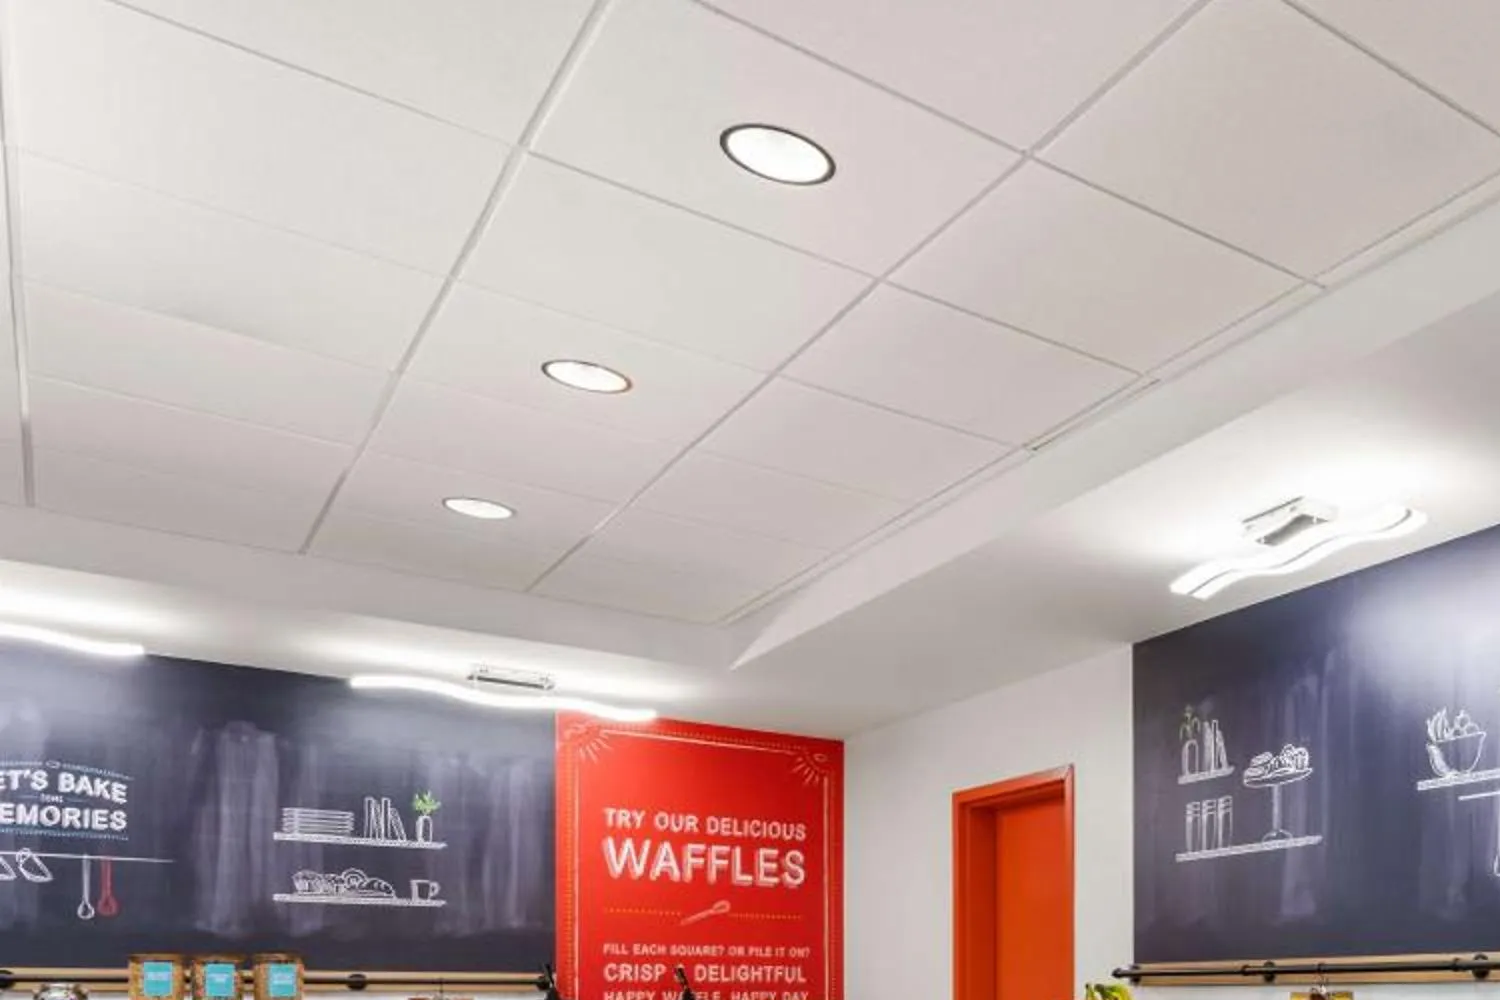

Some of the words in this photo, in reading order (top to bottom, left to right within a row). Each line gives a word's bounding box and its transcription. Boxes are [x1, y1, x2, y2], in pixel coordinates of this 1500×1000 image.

[58, 771, 128, 804] BAKE
[604, 807, 645, 829] TRY
[654, 811, 698, 833] OUR
[706, 815, 807, 841] DELICIOUS
[603, 836, 806, 888] WAFFLES
[603, 943, 628, 956] FILL
[633, 943, 667, 957] EACH
[669, 945, 725, 957] SQUARE?
[728, 946, 745, 957] OR
[748, 946, 772, 957] PILE
[774, 946, 785, 957] IT
[788, 946, 811, 958] ON?
[604, 963, 667, 982] CRISP
[694, 964, 807, 984] DELIGHTFUL
